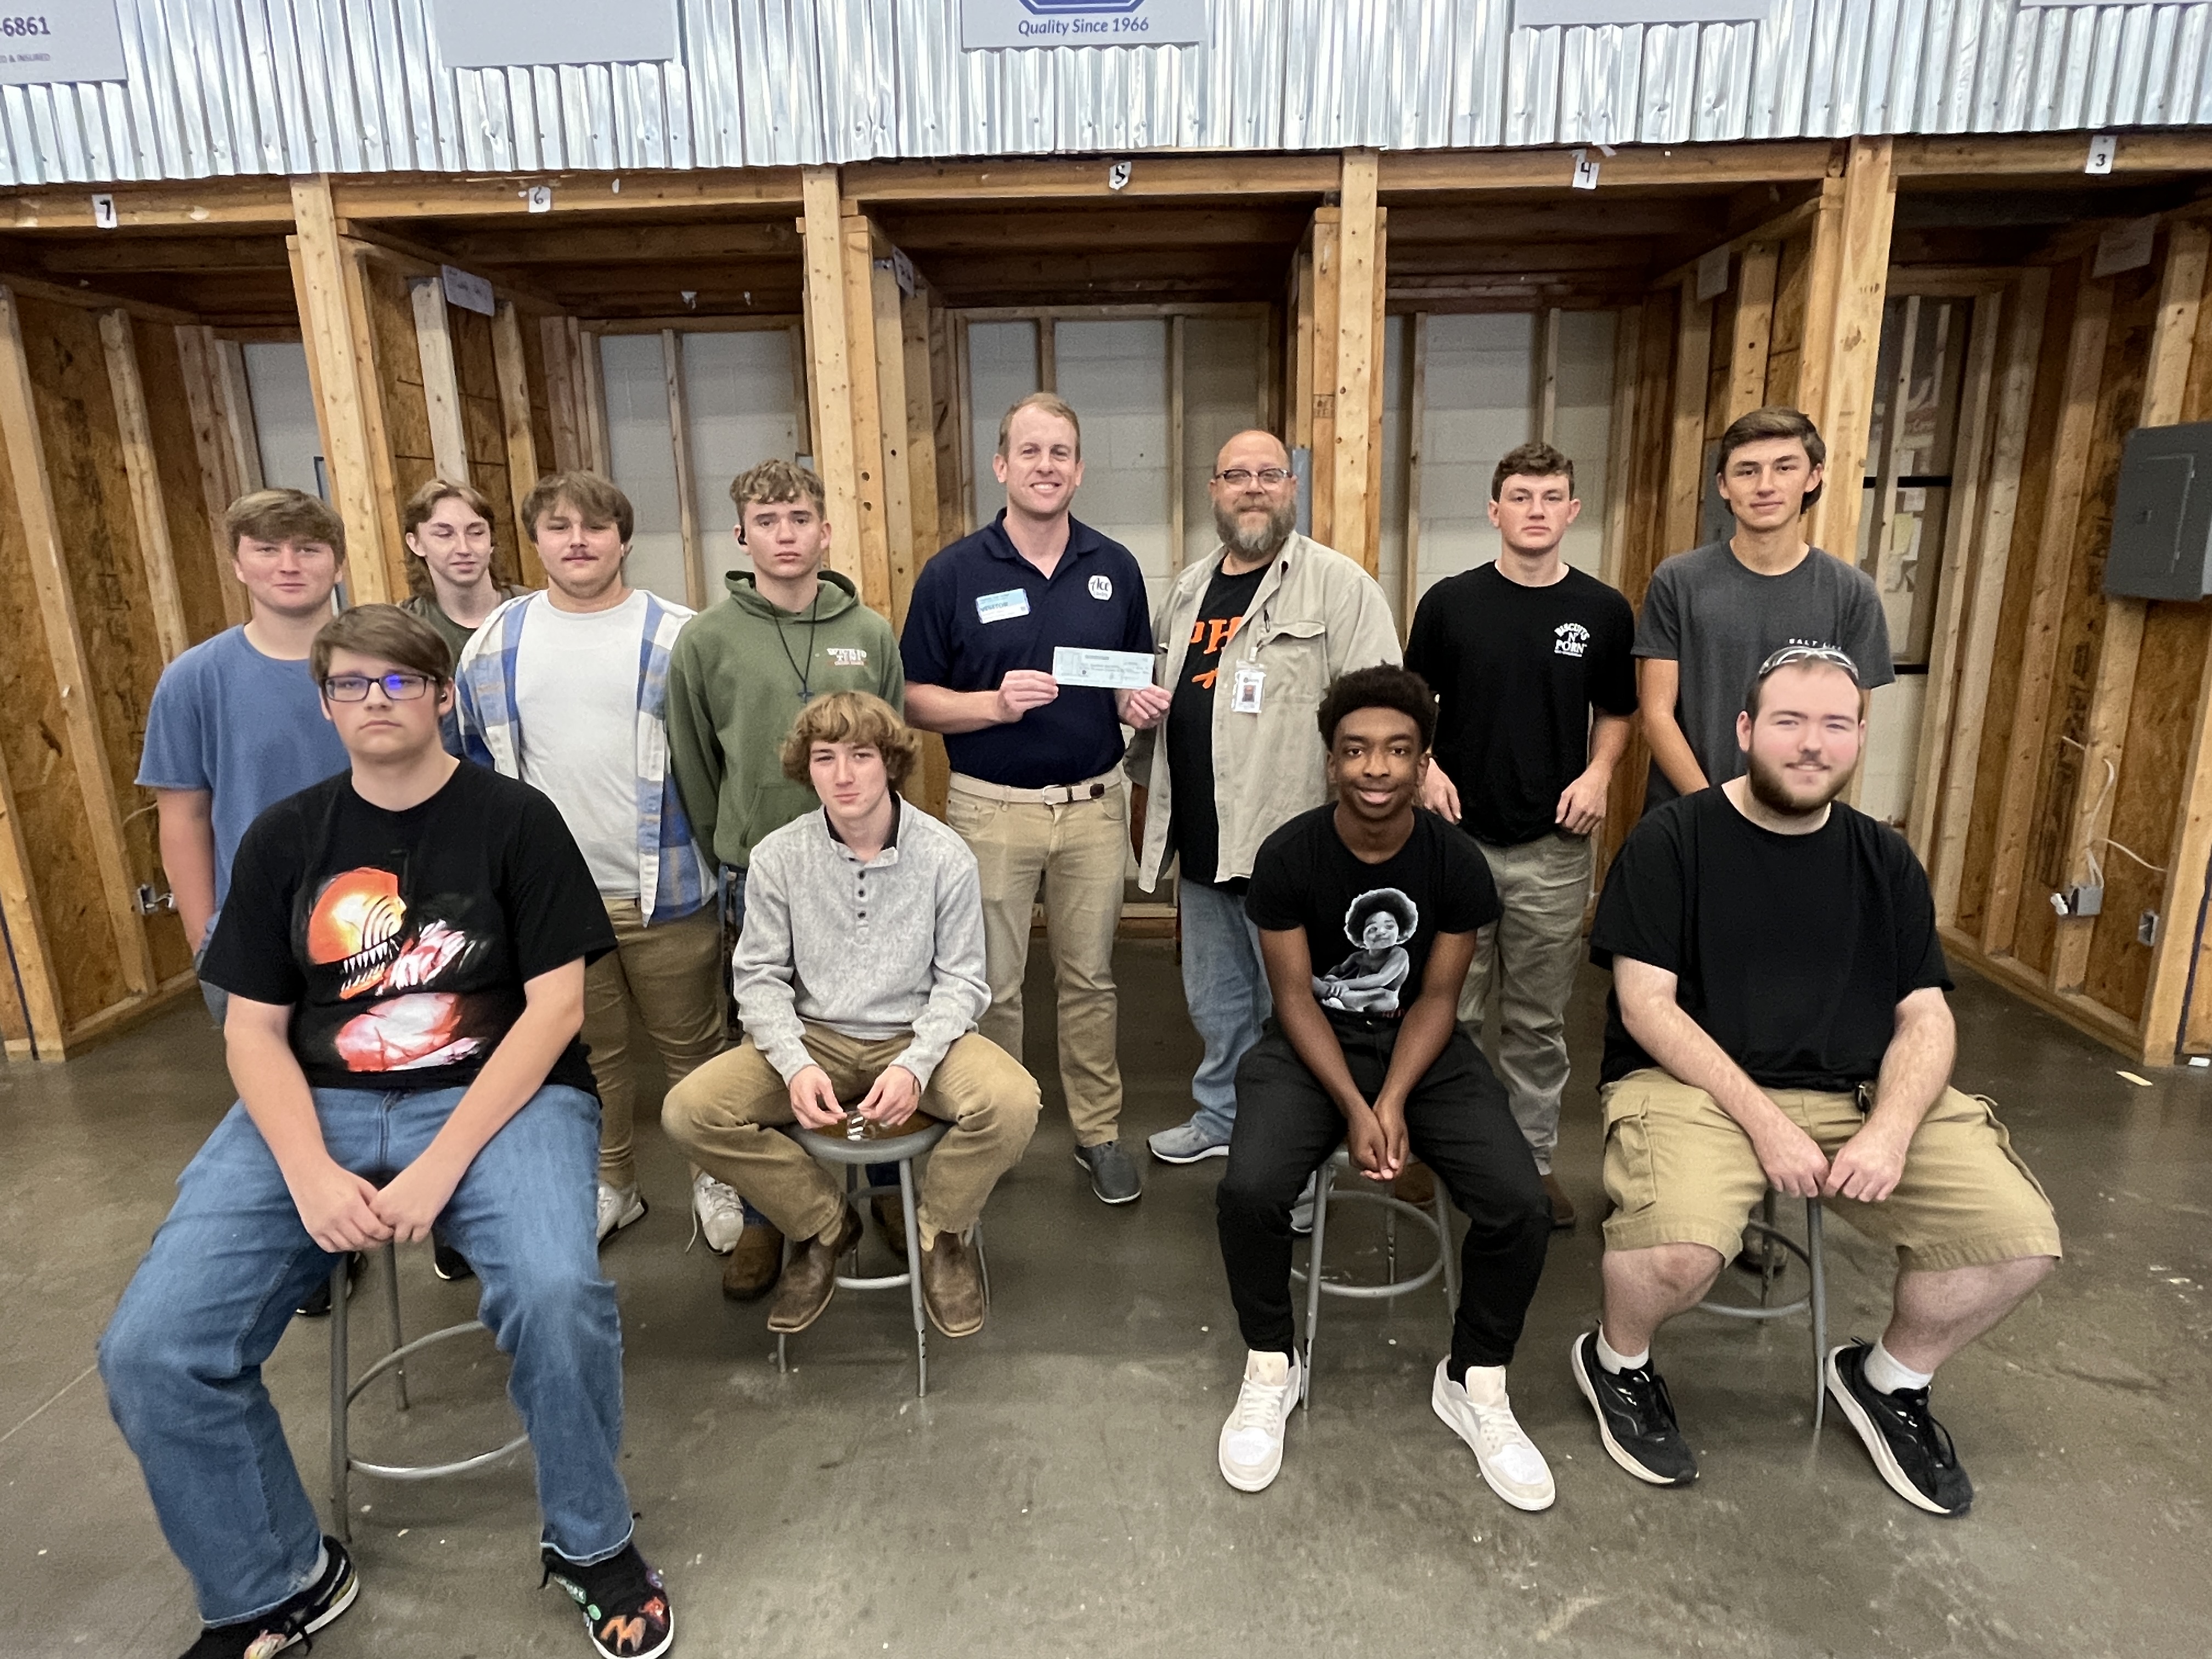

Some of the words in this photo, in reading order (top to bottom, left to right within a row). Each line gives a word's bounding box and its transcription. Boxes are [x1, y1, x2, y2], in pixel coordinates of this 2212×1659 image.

[1018, 20, 1070, 37] Quality
[1072, 18, 1108, 33] Since
[1113, 17, 1149, 32] 1966
[2096, 154, 2106, 167] 3
[1581, 162, 1592, 183] 4
[534, 186, 544, 205] 6
[99, 200, 111, 221] 7
